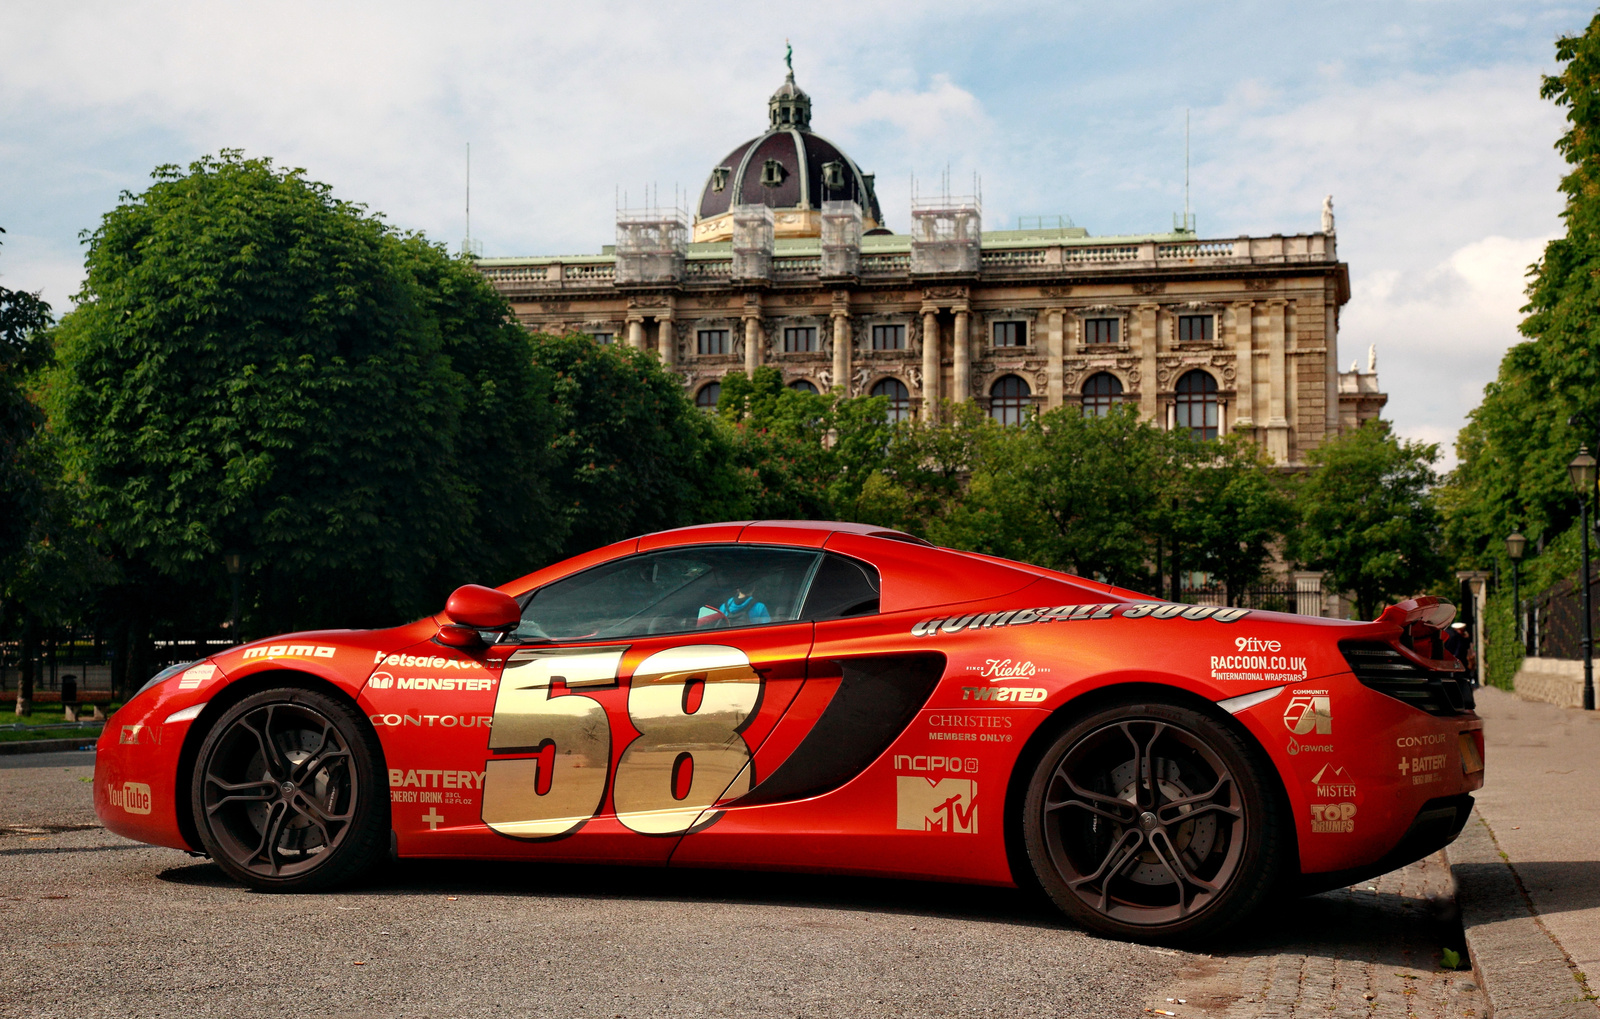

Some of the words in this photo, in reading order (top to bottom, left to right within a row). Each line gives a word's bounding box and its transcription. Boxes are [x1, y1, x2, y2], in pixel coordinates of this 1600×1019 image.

[911, 603, 1120, 637] GUMBALL
[1121, 603, 1252, 623] 3000
[242, 645, 336, 659] momo
[1235, 637, 1281, 652] 9five
[981, 659, 1036, 677] Kiehl's
[1211, 656, 1307, 671] RACCOON.CO.UK
[961, 687, 1048, 702] TWISTED
[370, 714, 493, 727] CONTOUR
[929, 715, 1012, 728] CHRISTIE'S
[481, 644, 766, 843] 58
[929, 732, 977, 741] MEMBERS
[1396, 734, 1446, 748] CONTOUR
[1300, 744, 1334, 752] rawnet
[894, 755, 962, 772] INCIPIO
[1412, 754, 1447, 773] BATTERY
[388, 769, 487, 789] BATTERY
[108, 781, 151, 815] YouTube
[420, 791, 443, 803] DRINK
[1317, 785, 1356, 797] MISTER
[896, 775, 979, 835] MTV
[1310, 802, 1357, 821] TOP
